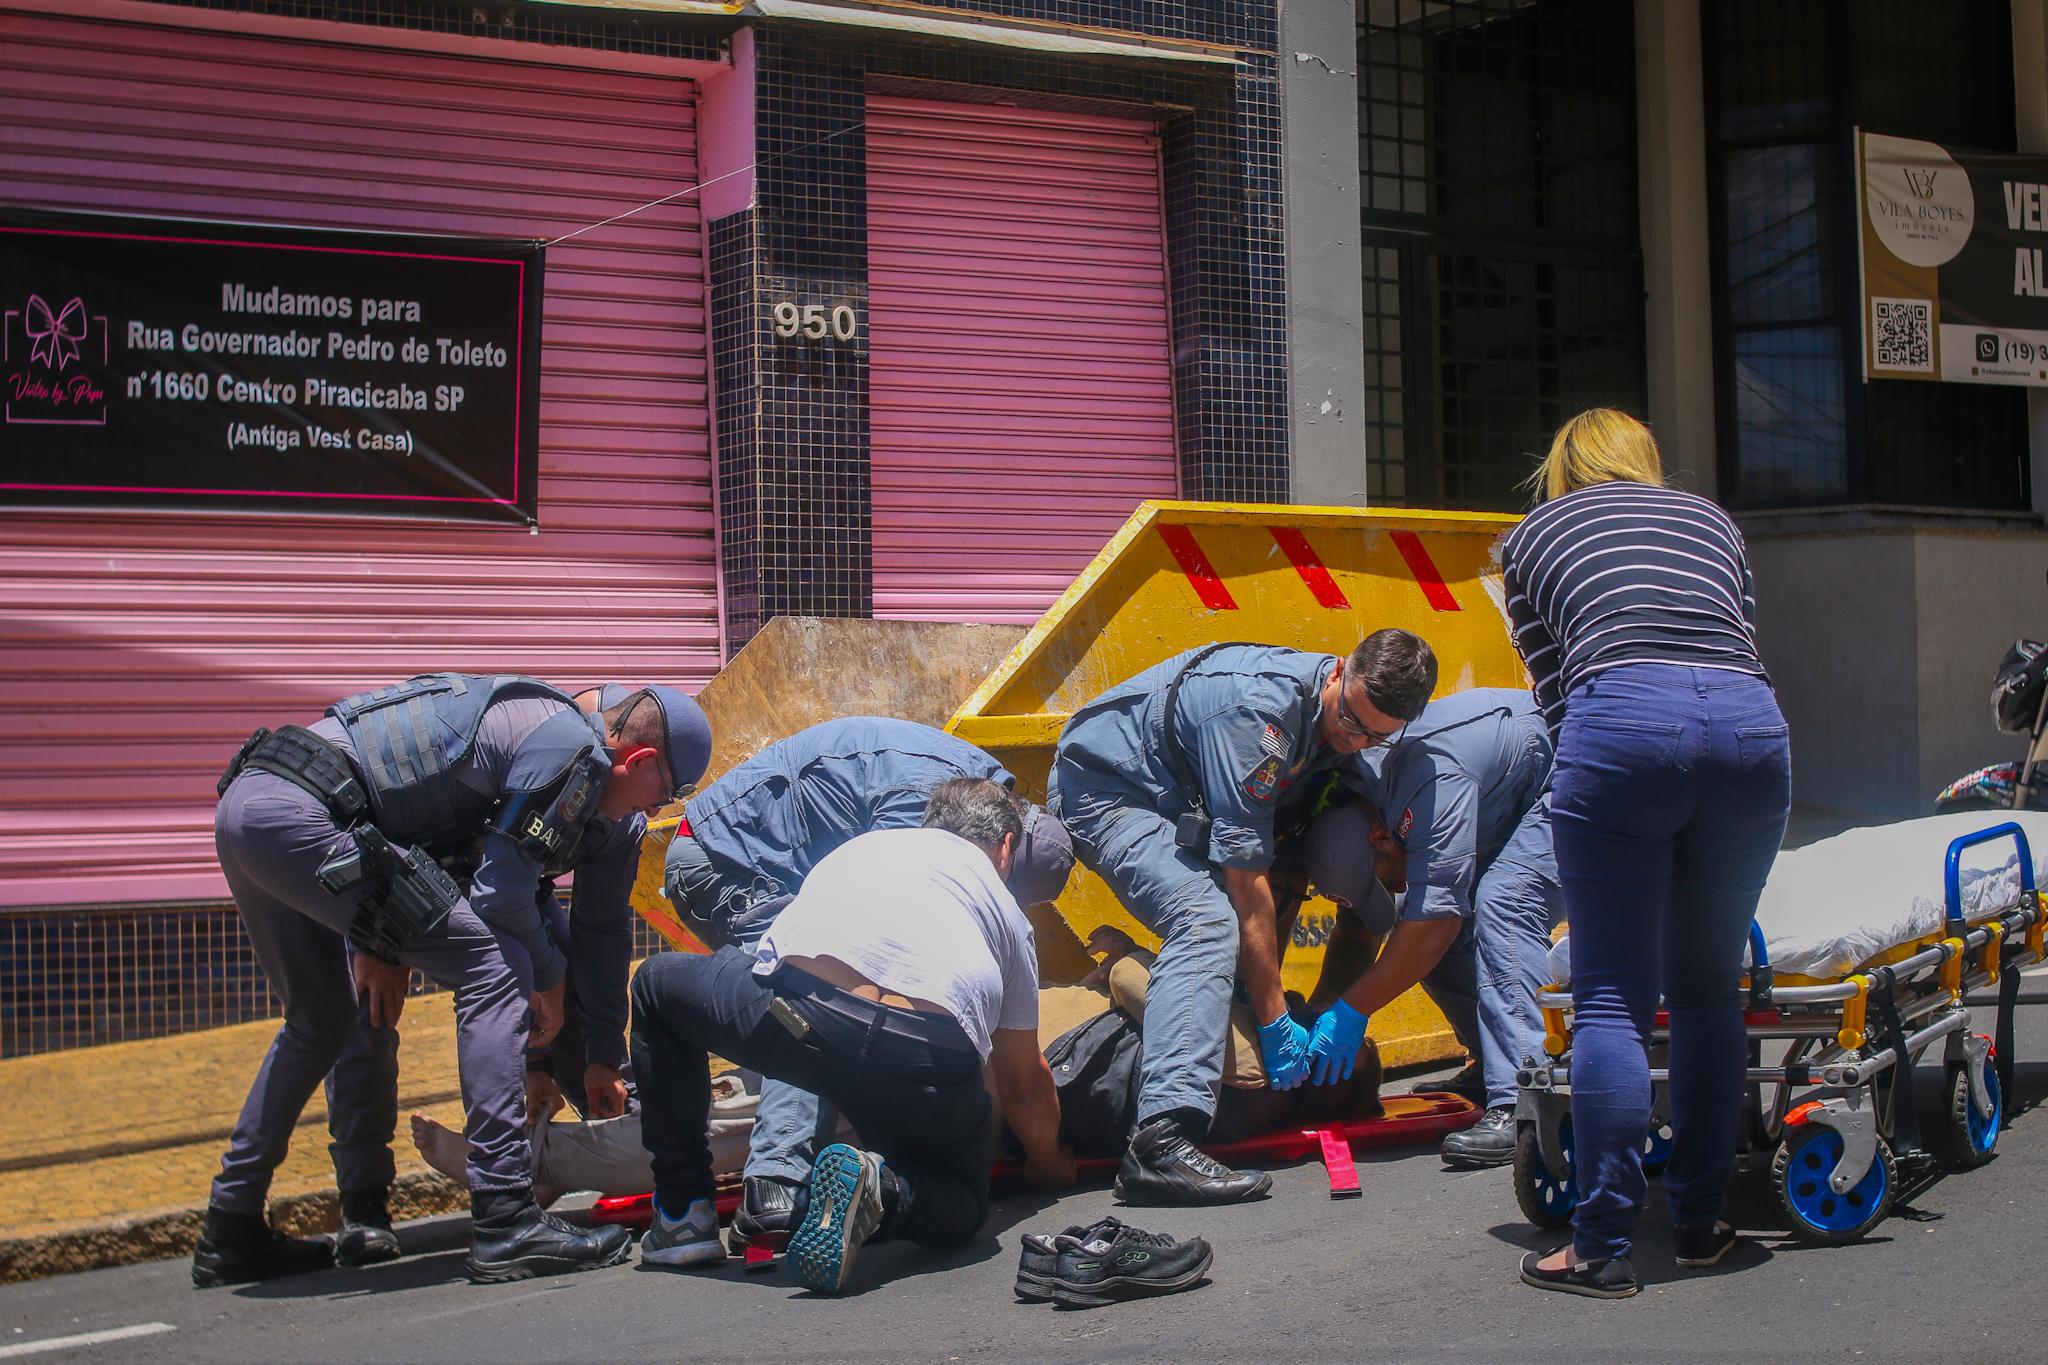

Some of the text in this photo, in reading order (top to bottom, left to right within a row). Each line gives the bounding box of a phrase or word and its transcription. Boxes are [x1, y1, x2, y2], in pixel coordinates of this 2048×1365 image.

[1879, 200, 1965, 222] VILA BOYES
[222, 283, 421, 326] Mudamos para
[774, 302, 856, 341] 950
[127, 321, 507, 368] Rua Governador Pedro de Toleto
[2005, 342, 2035, 364] (19)
[217, 373, 297, 405] Centro
[304, 378, 428, 411] Piracicaba
[434, 385, 465, 412] SP
[227, 422, 414, 457] (Antiga Vest Casa)
